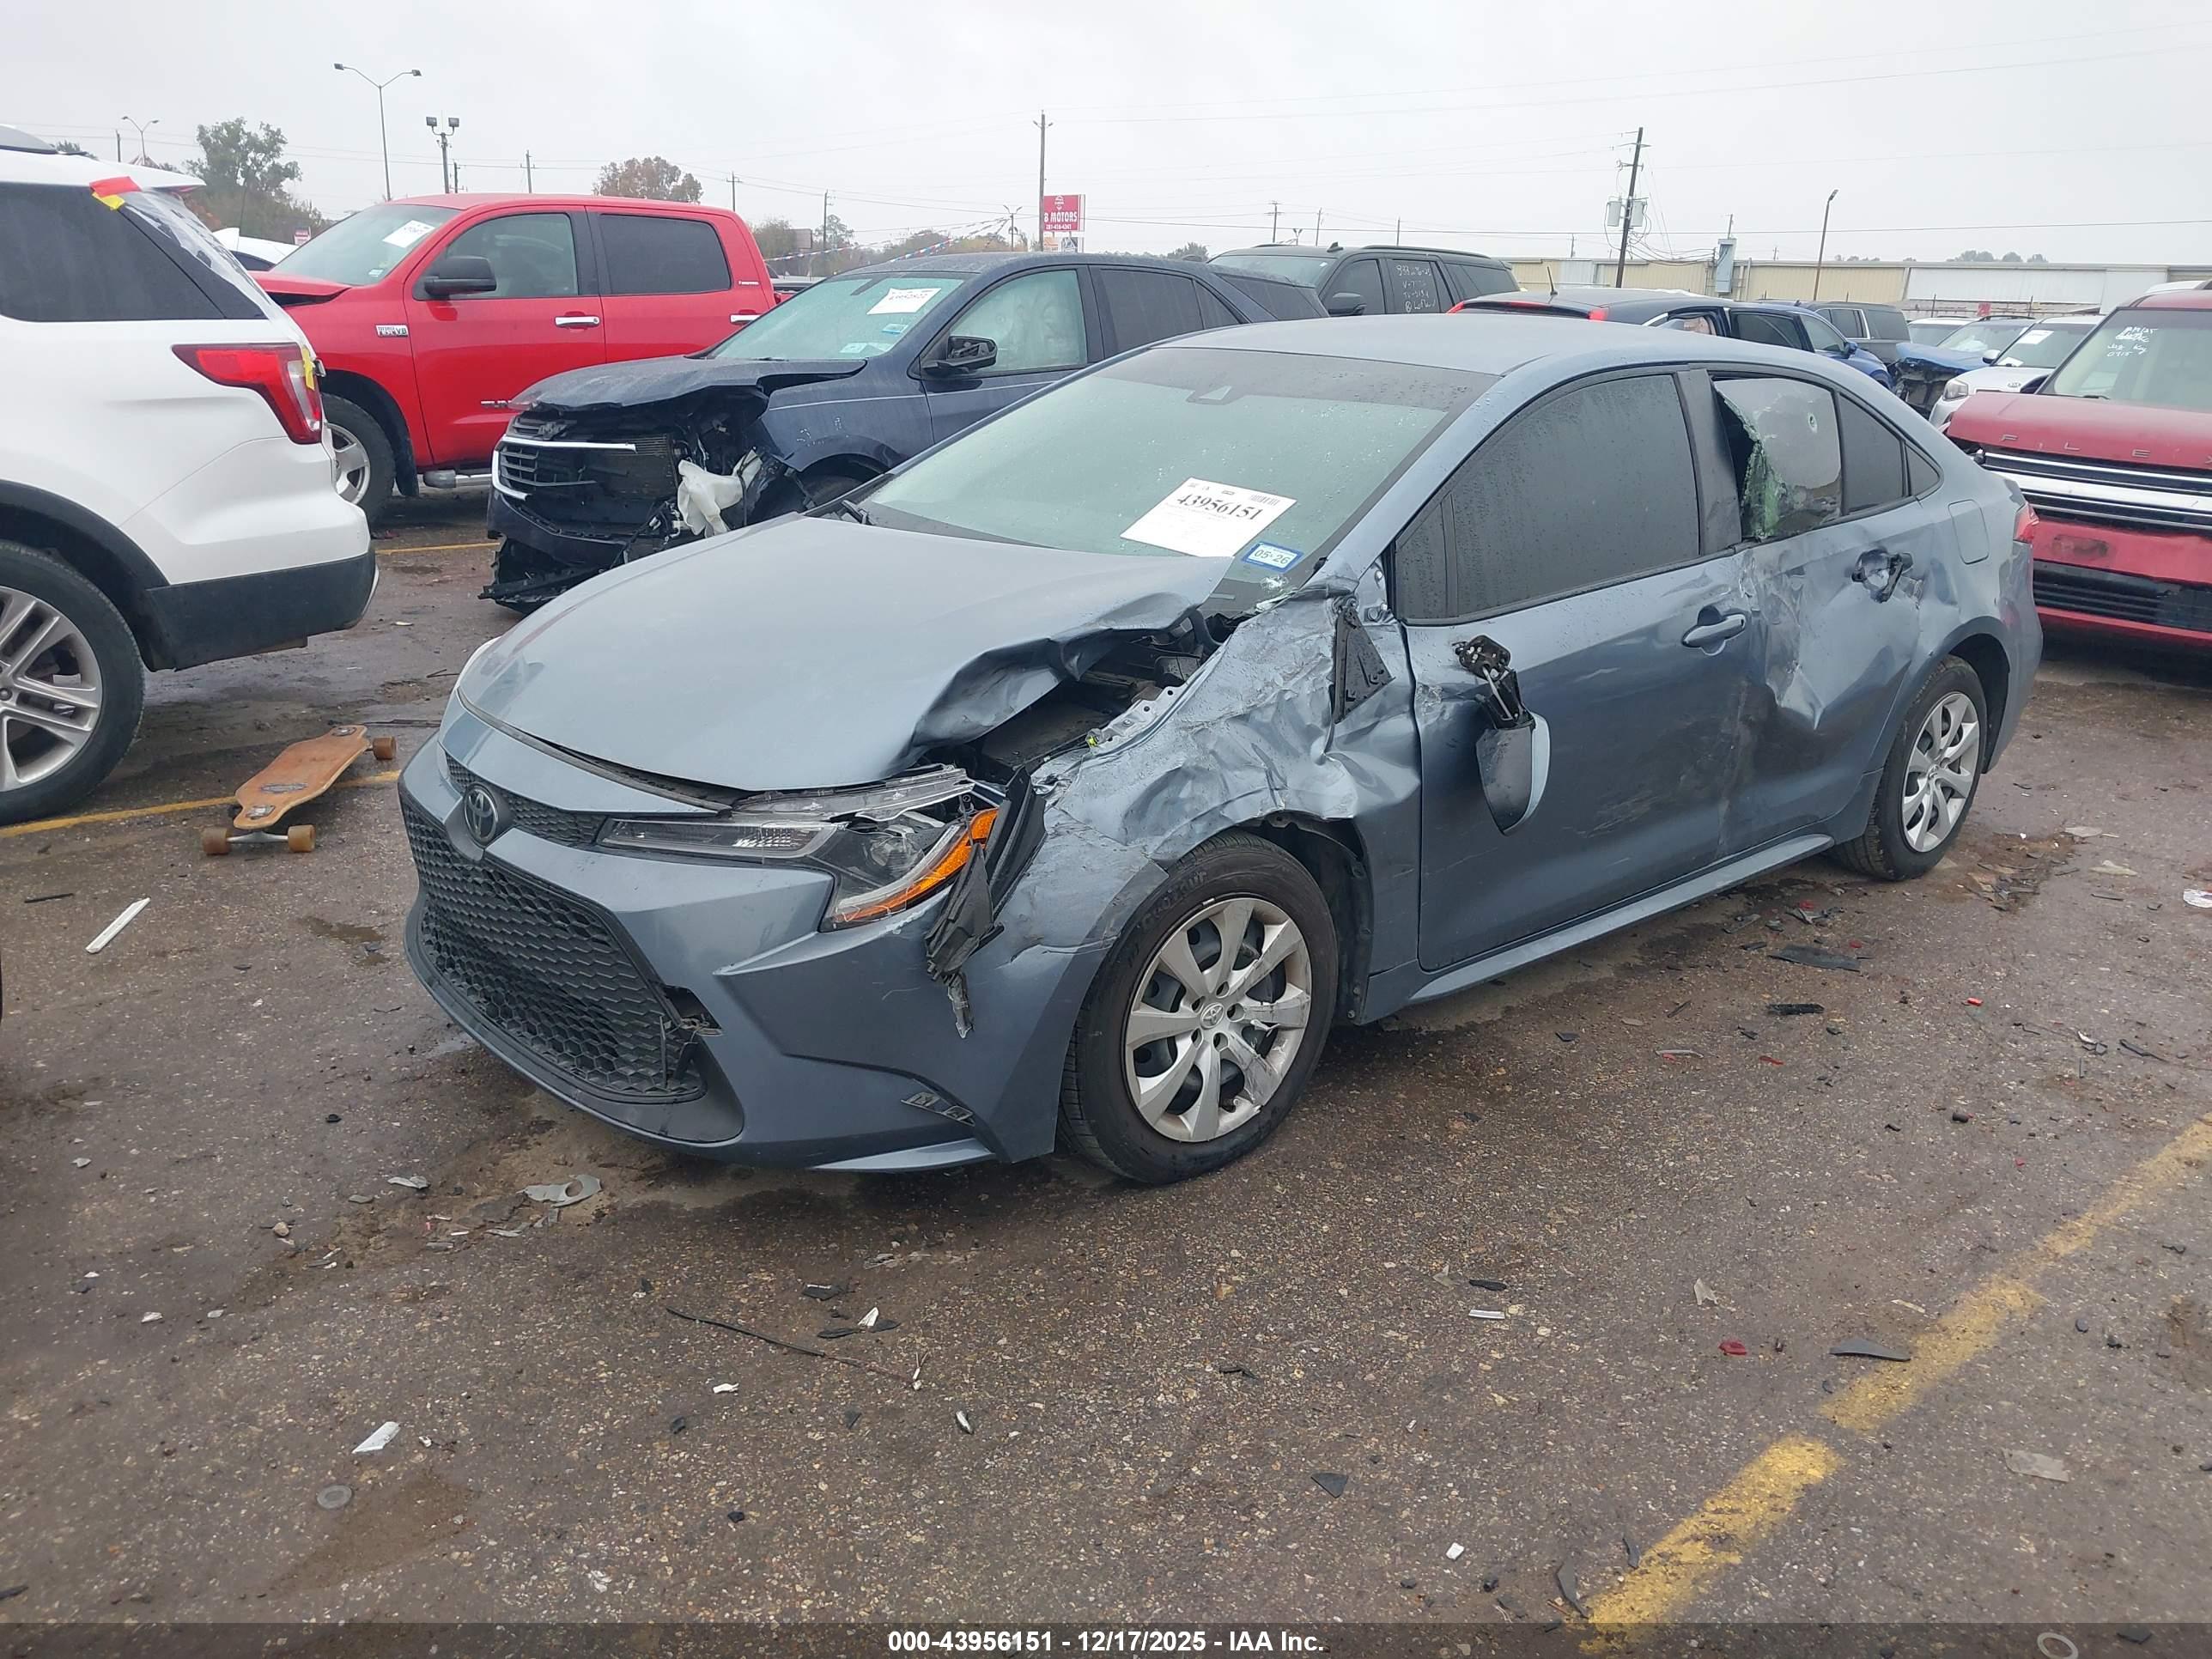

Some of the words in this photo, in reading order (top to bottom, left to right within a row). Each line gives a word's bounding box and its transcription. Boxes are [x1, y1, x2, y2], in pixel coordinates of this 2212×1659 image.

[1050, 211, 1078, 222] MOTORS
[1177, 494, 1263, 520] 43956151
[1255, 550, 1271, 558] 05
[1273, 554, 1291, 564] 26
